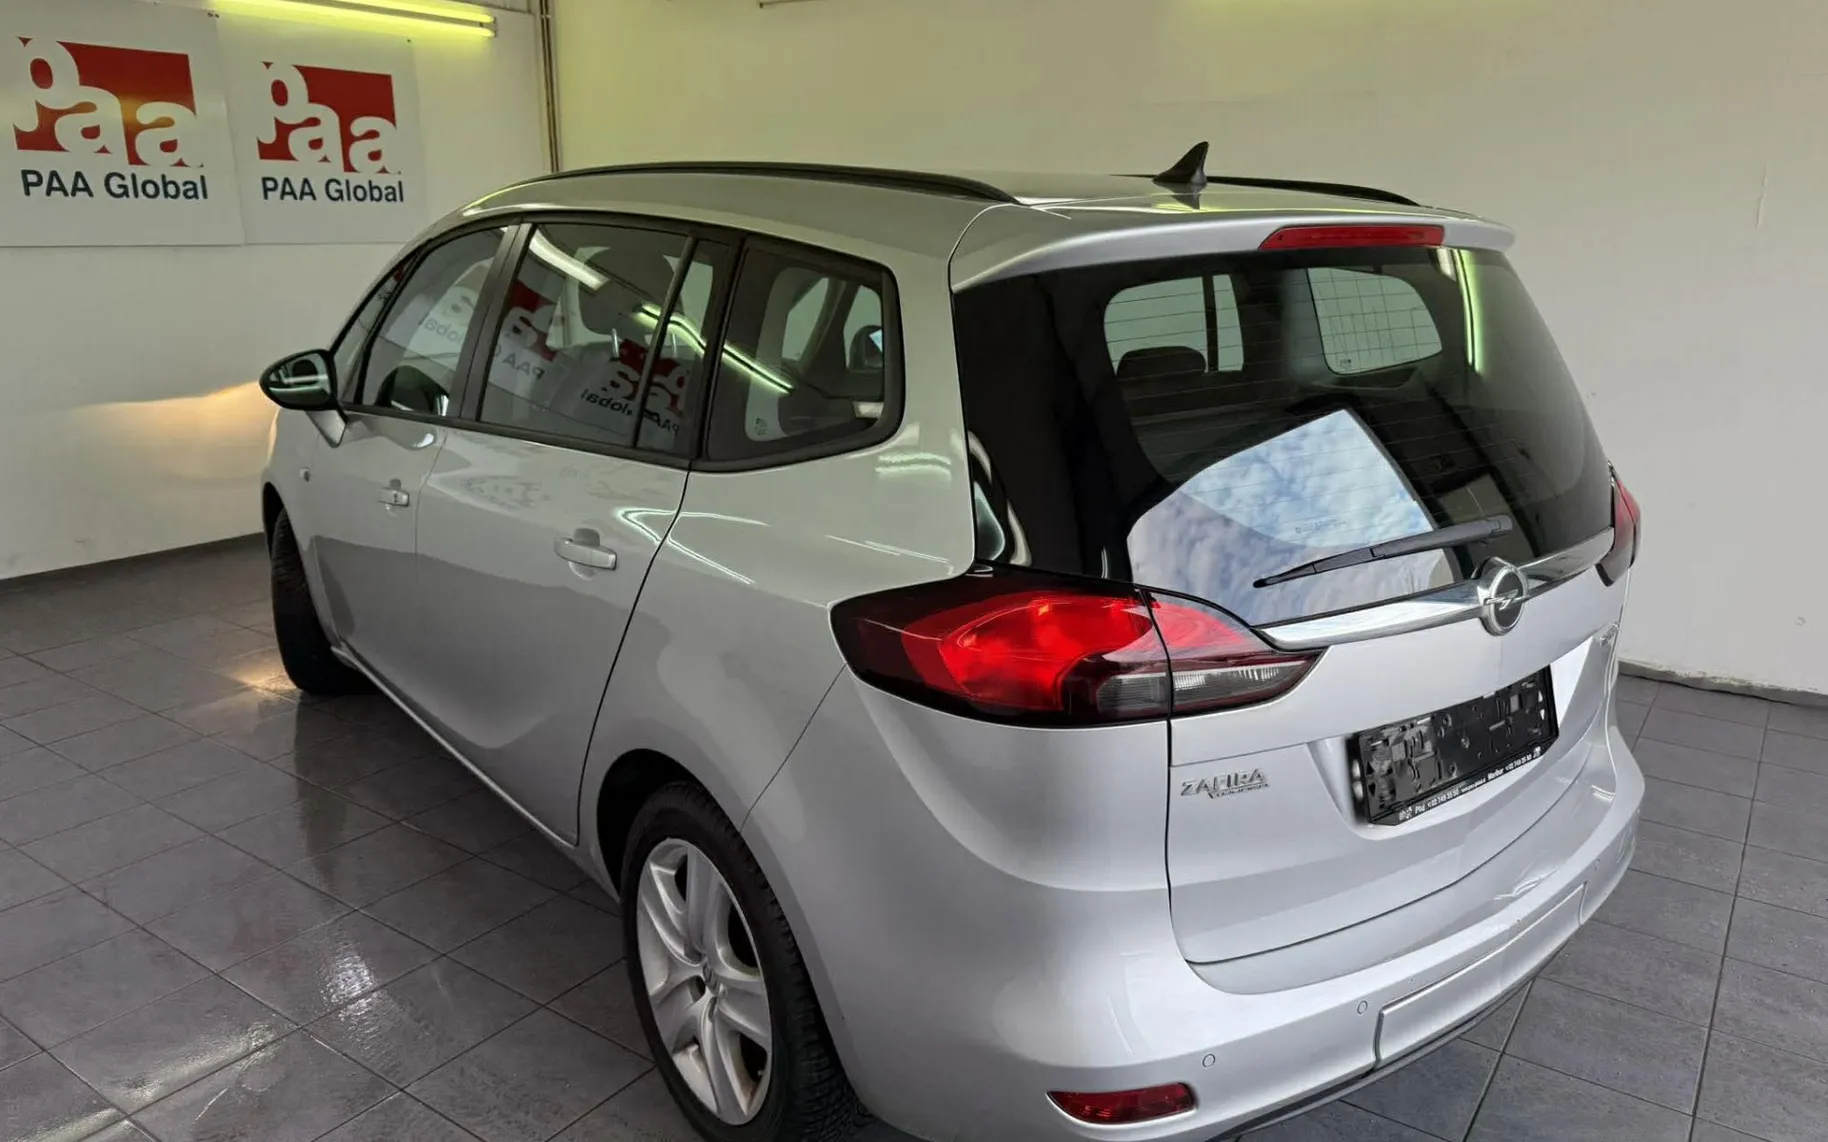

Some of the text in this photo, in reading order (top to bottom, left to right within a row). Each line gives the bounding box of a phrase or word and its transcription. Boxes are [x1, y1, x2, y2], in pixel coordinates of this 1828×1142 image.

[21, 169, 209, 201] PAA Global
[261, 177, 404, 203] PAA Global
[1180, 768, 1267, 797] ZAFIRA
